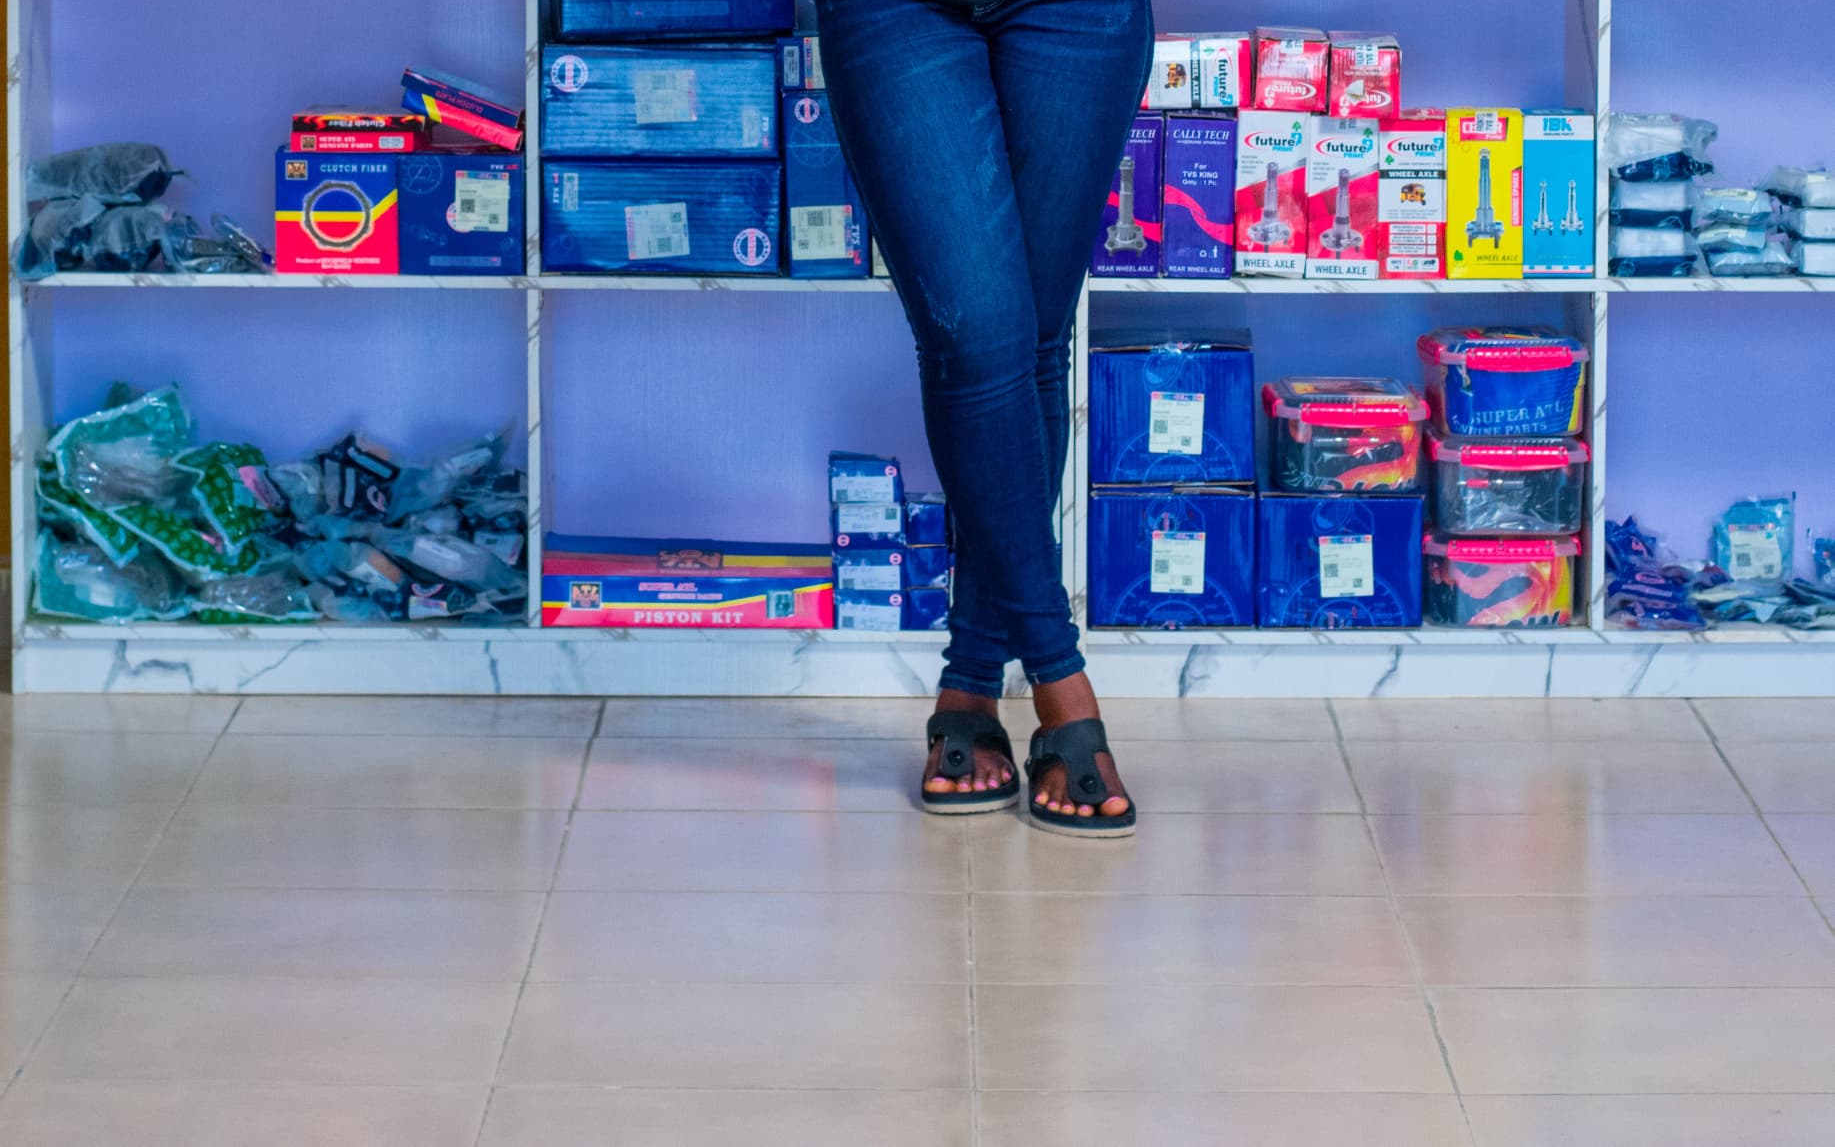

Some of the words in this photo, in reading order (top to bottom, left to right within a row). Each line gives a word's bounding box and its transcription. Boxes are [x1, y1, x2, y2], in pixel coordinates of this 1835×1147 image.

[1218, 58, 1228, 98] future
[1270, 85, 1306, 96] future
[1543, 118, 1572, 132] IBK
[1130, 129, 1156, 138] TECH
[1173, 128, 1204, 139] CALLY
[1205, 130, 1230, 140] TECH
[1255, 136, 1295, 146] future
[1398, 141, 1438, 151] future
[1326, 142, 1366, 152] future
[320, 164, 357, 172] CLUTCH
[361, 164, 387, 172] FIBER
[851, 224, 860, 245] TVS
[1243, 258, 1270, 268] WHEEL
[1274, 259, 1295, 269] AXLE
[1315, 266, 1343, 275] WHEEL
[1346, 266, 1368, 275] AXLE
[633, 611, 702, 623] PISTON
[712, 612, 744, 623] KIT
